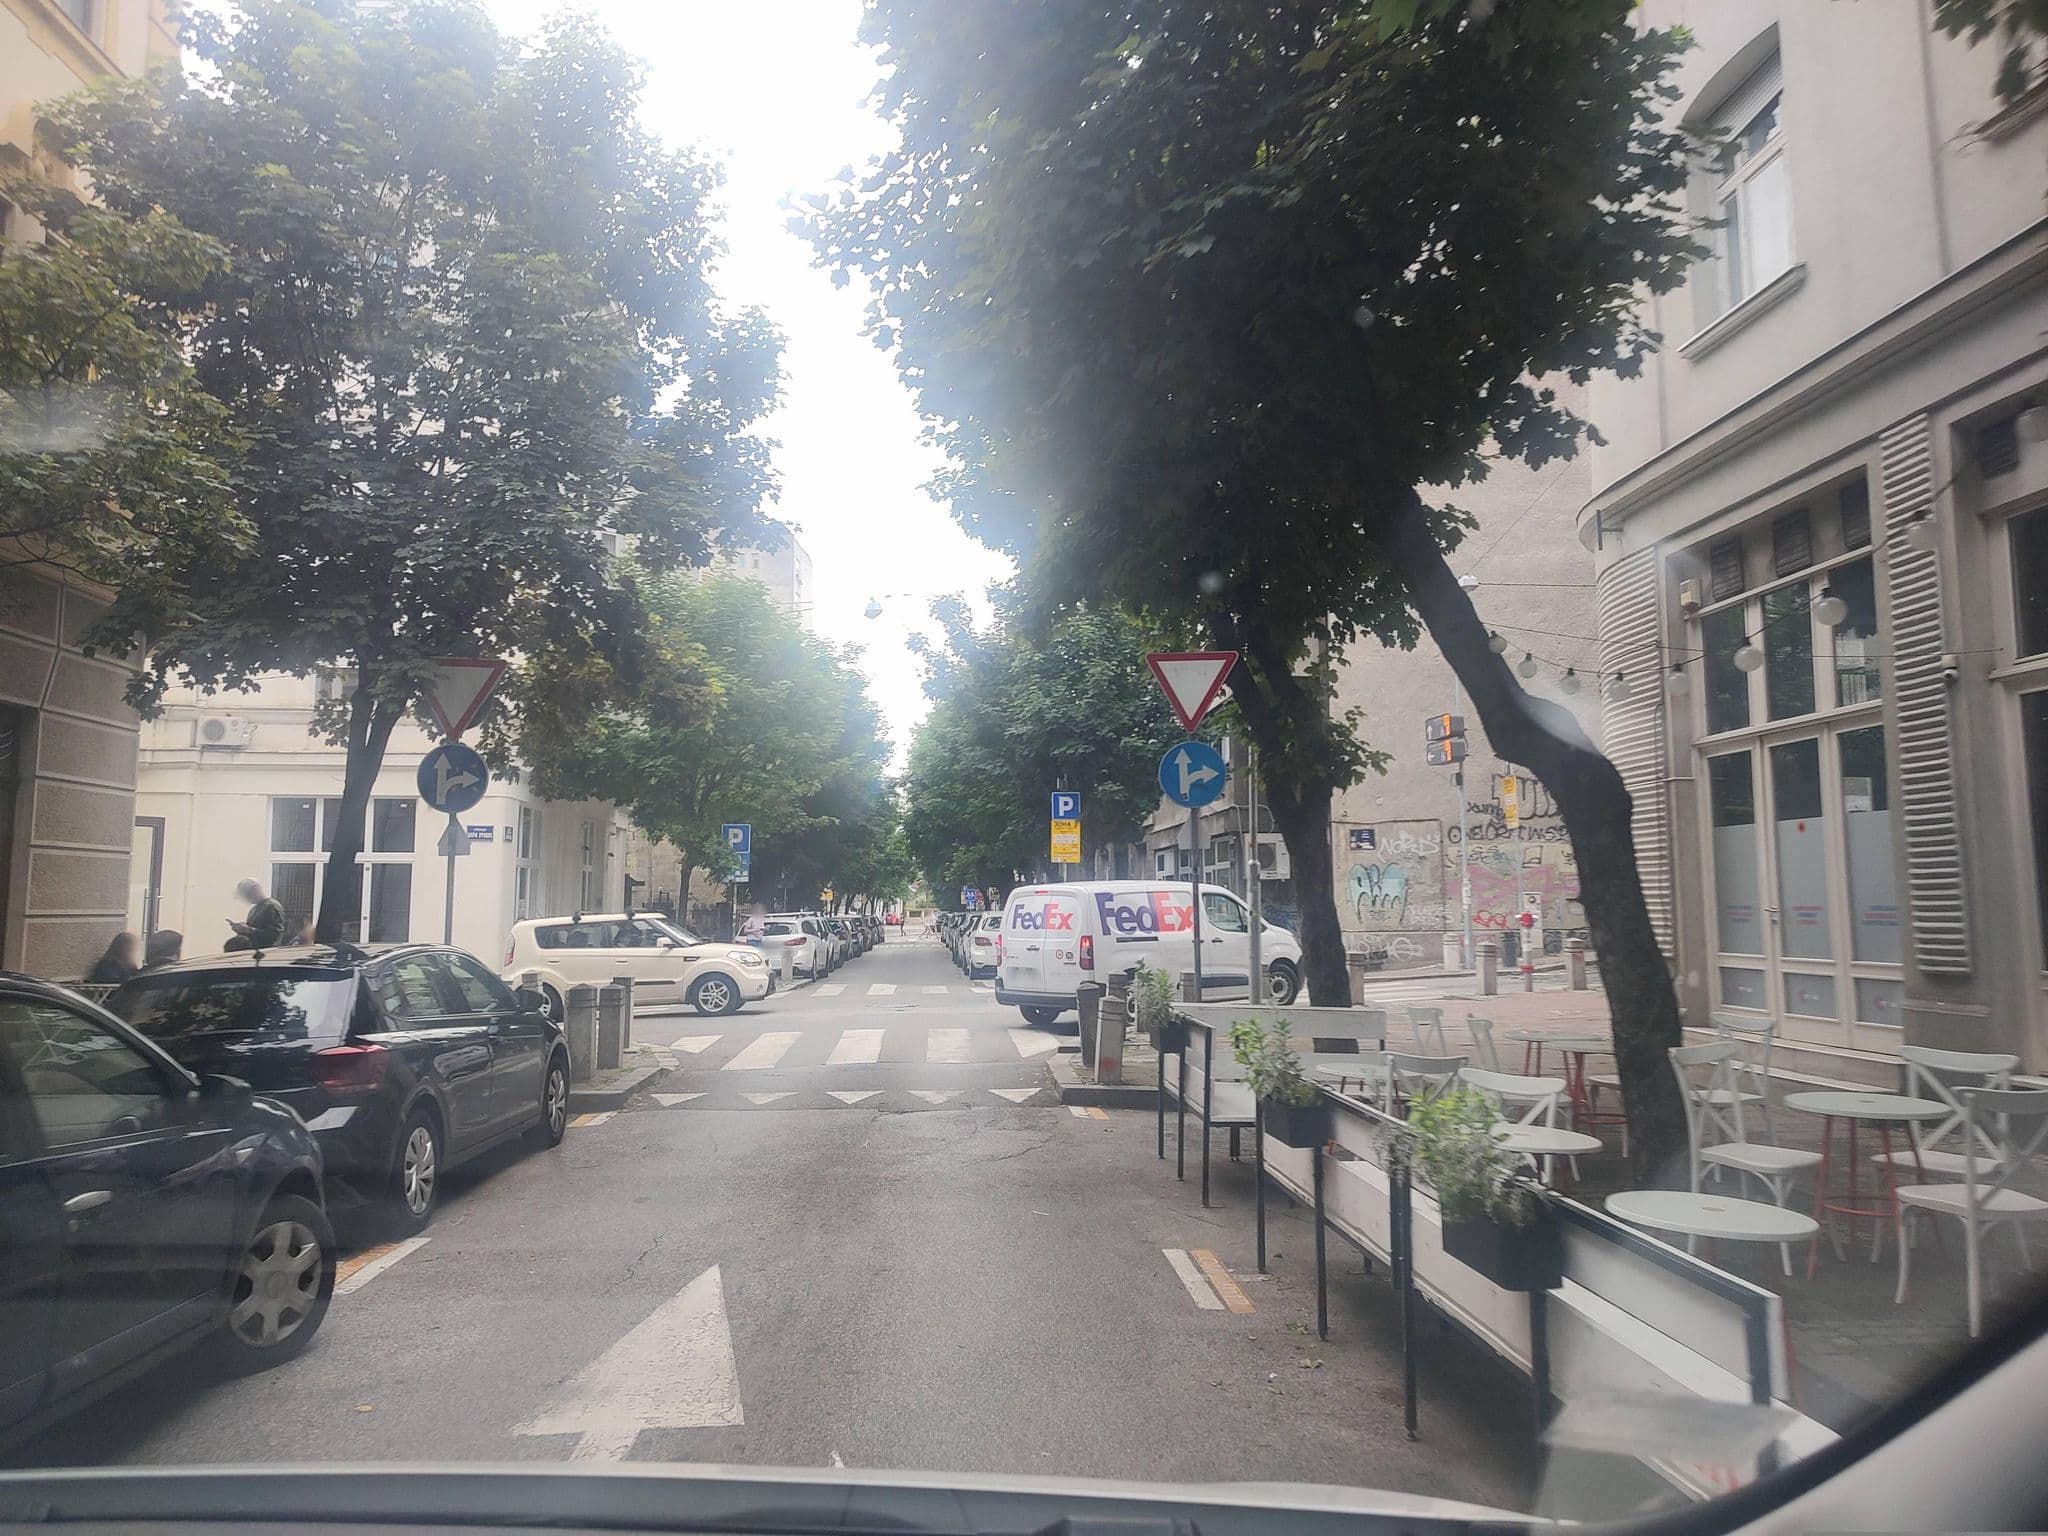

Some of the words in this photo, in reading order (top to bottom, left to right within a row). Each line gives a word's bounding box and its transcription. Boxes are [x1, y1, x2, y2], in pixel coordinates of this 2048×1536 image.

[1058, 796, 1074, 817] P
[728, 828, 744, 849] P
[1012, 903, 1073, 931] FedEx
[1094, 891, 1194, 936] FedEx
